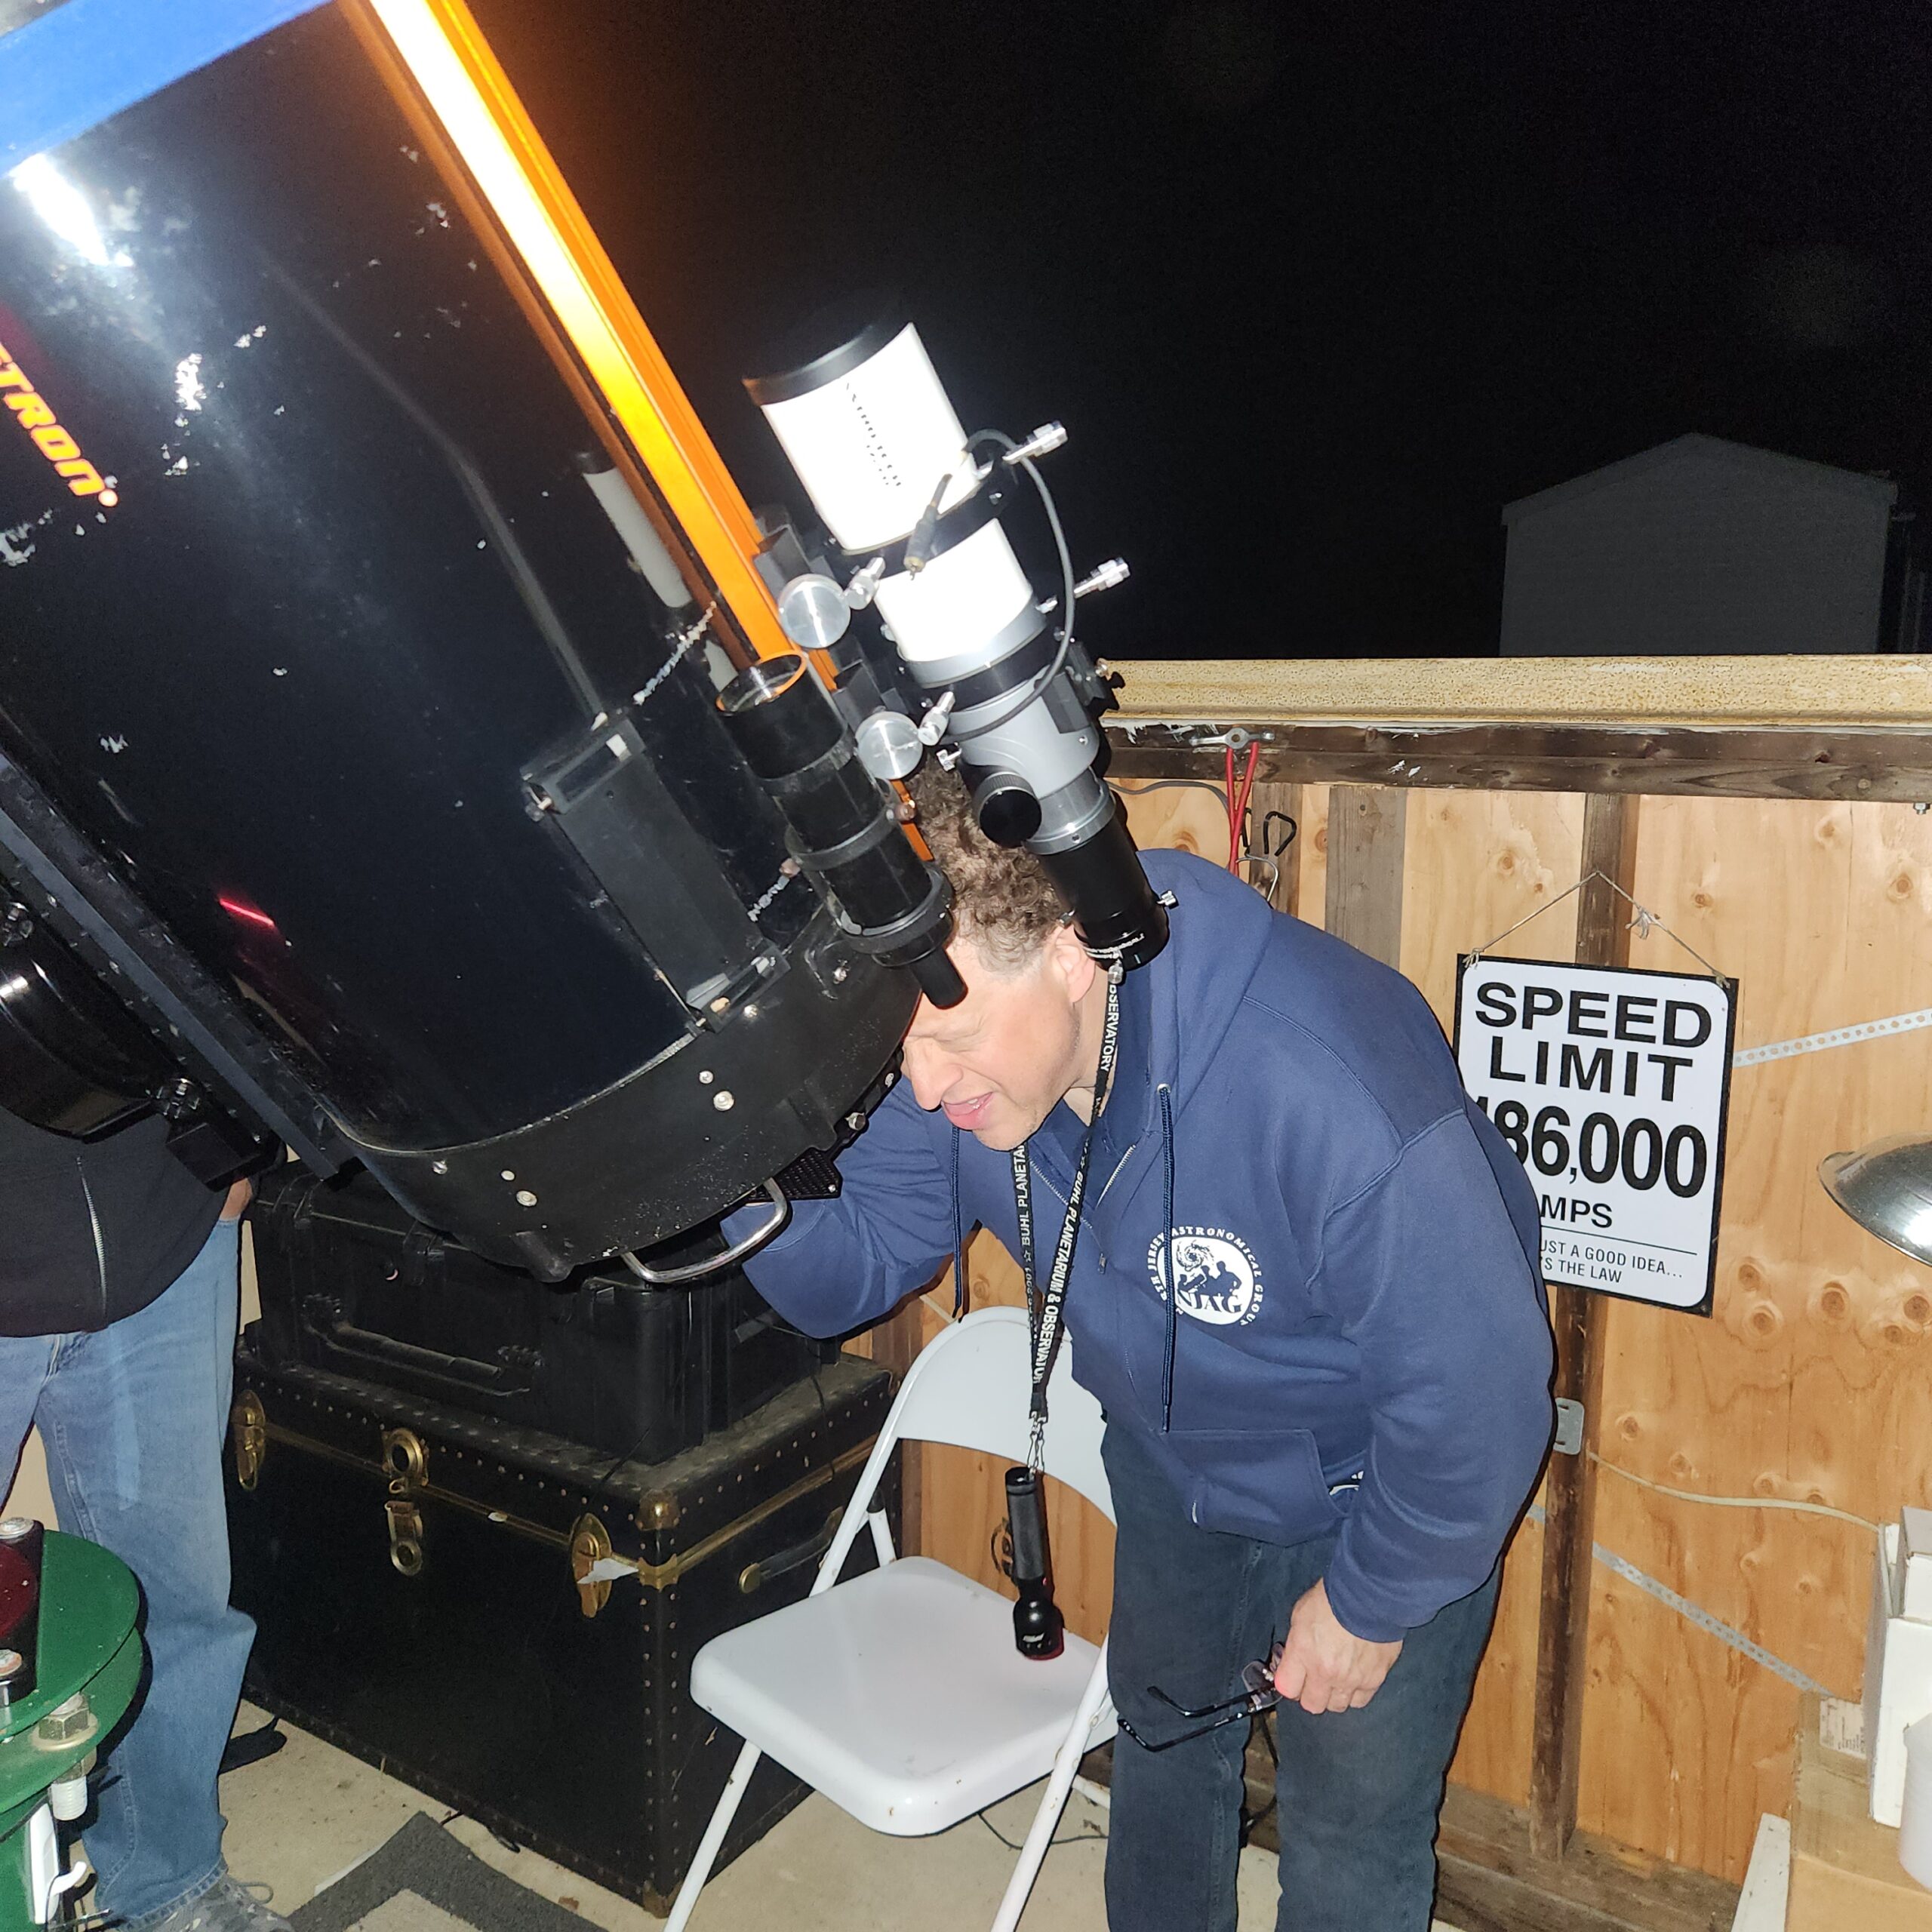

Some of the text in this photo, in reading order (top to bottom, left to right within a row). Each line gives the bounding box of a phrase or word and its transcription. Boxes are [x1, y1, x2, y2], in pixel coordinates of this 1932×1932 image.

[1475, 982, 1712, 1048] SPEED
[1490, 1036, 1693, 1102] LIMIT
[1476, 1096, 1707, 1198] 86,000
[1070, 1171, 1084, 1204] BUHL
[1540, 1194, 1613, 1229] MPS
[1020, 1213, 1030, 1246] BUHL
[1050, 1207, 1078, 1291] PLANETARIUM
[1147, 1232, 1164, 1271] JERSEY
[1171, 1226, 1263, 1278] ASTRONOMICAL
[1571, 1244, 1580, 1258] A
[1585, 1247, 1626, 1266] GOOD
[1558, 1260, 1586, 1277] THE
[1590, 1266, 1623, 1284] LAW
[1047, 1294, 1061, 1303] &
